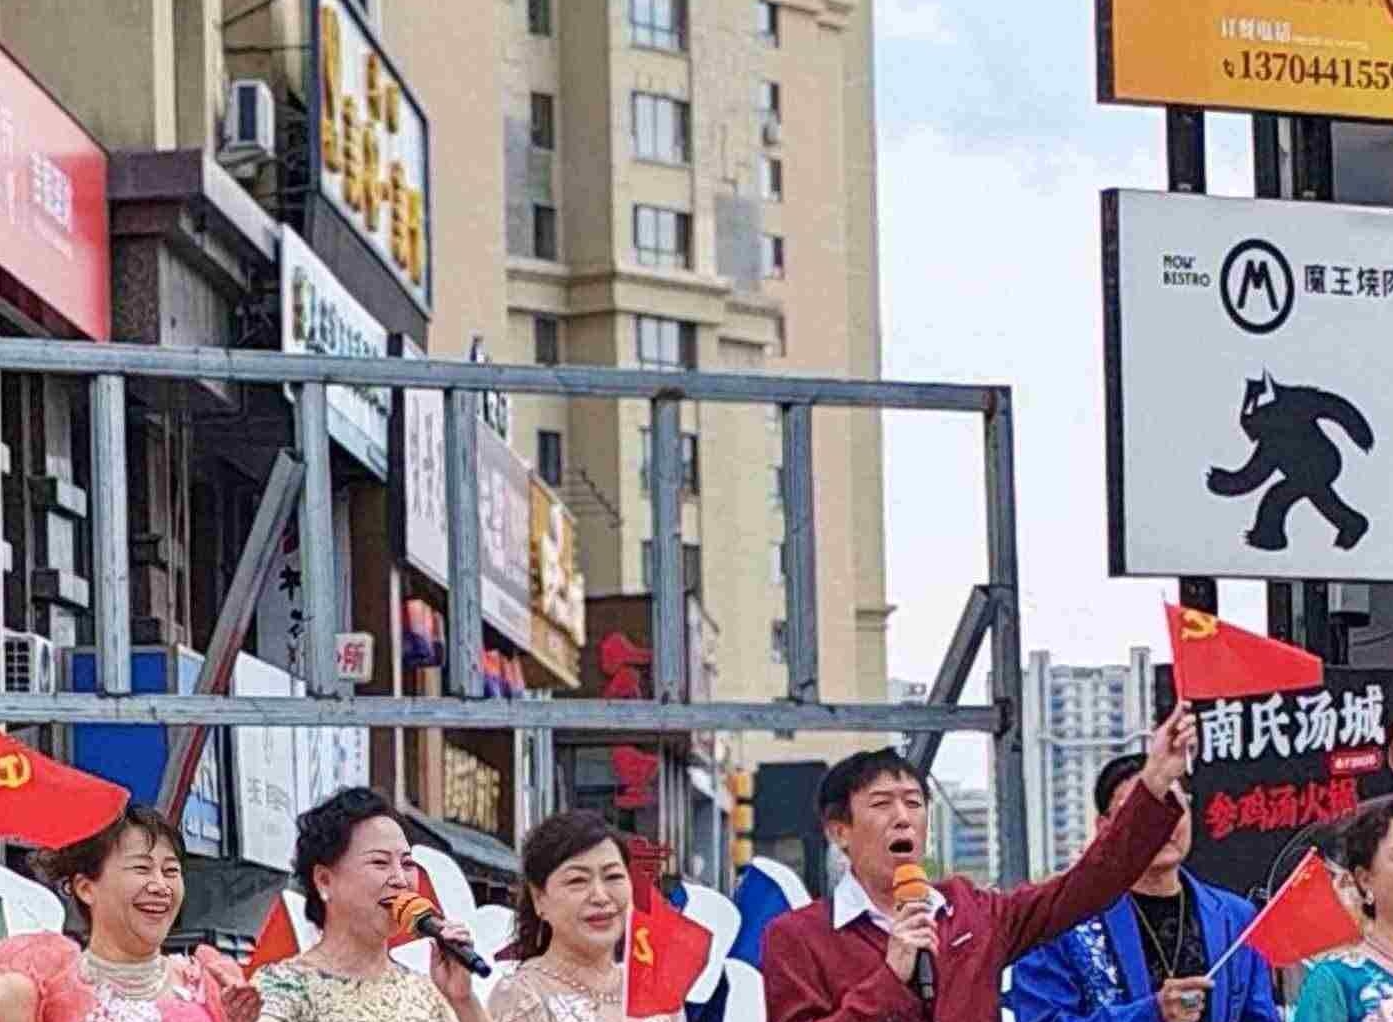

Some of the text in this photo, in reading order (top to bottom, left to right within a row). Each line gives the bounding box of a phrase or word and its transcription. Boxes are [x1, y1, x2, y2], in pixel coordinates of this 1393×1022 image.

[1240, 51, 1393, 90] 137044155
[1200, 684, 1386, 763] 南氏汤城
